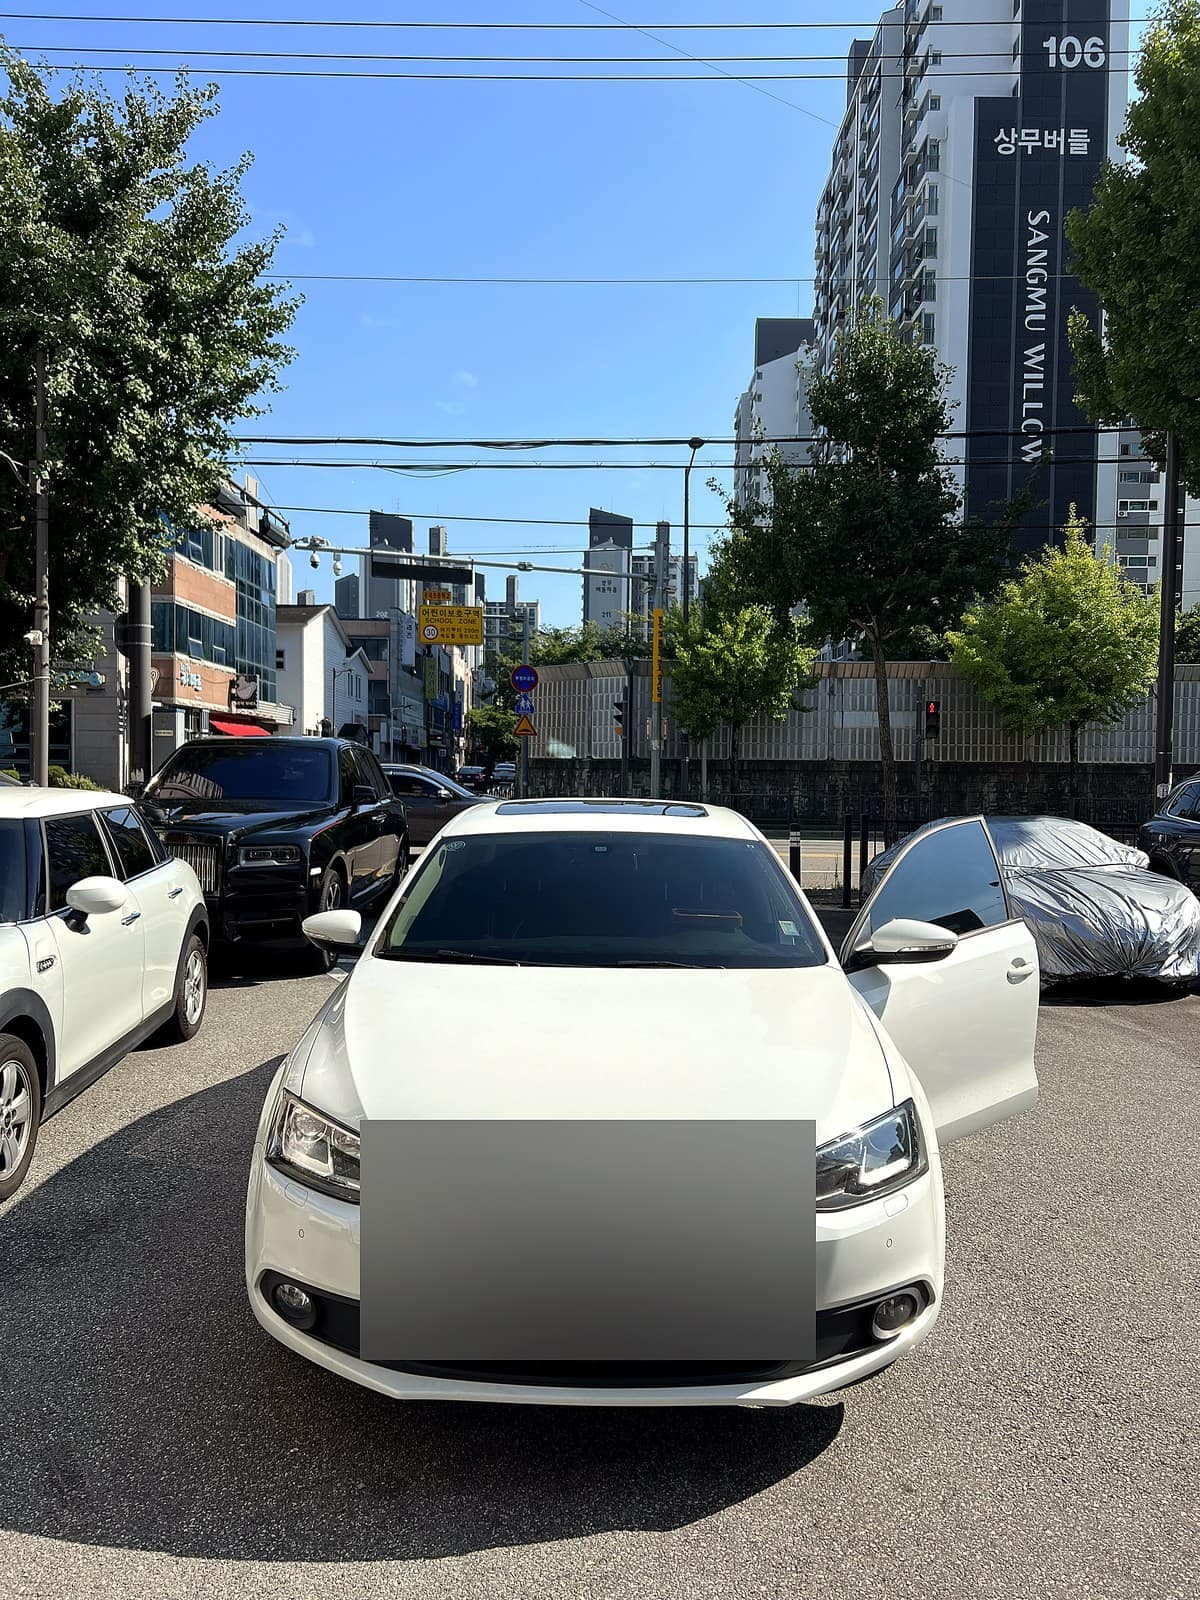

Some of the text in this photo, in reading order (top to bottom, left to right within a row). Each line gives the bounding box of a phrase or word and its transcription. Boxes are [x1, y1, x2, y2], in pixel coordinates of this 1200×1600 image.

[1042, 36, 1106, 69] 106
[993, 127, 1091, 156] 상무버들
[1023, 210, 1050, 332] SANGMU
[422, 608, 480, 618] 어린이보호구역
[426, 628, 435, 636] 30
